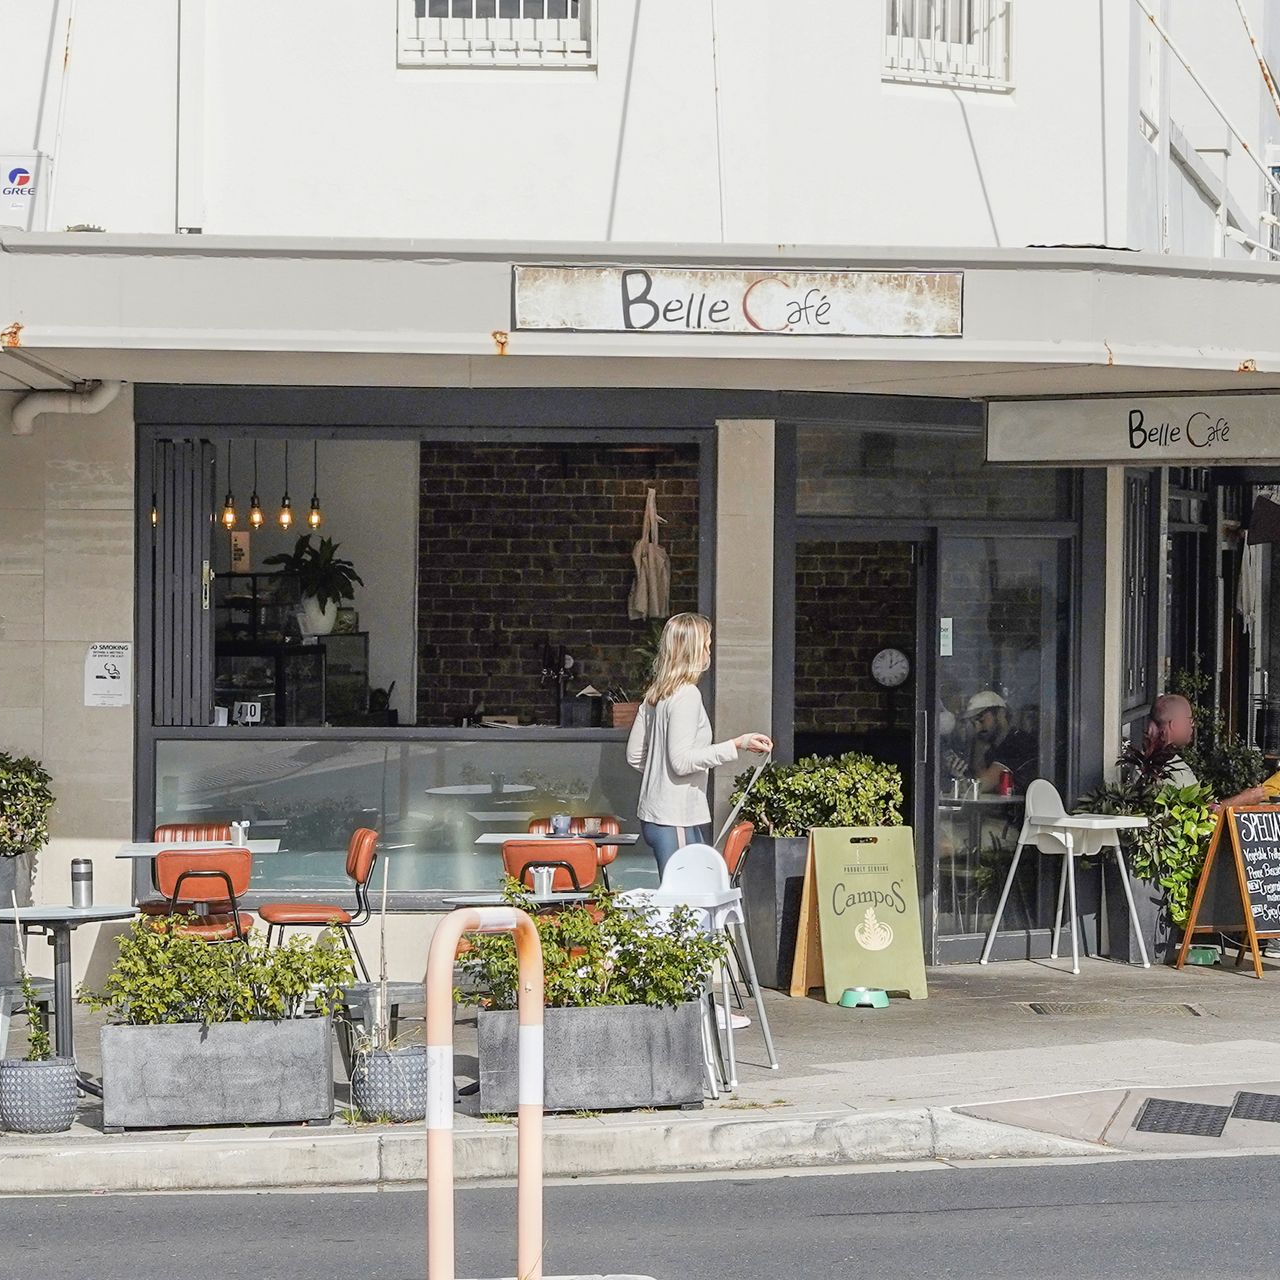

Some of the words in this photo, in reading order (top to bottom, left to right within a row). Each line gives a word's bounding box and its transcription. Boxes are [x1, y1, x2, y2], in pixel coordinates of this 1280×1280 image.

[2, 187, 36, 196] GREE
[621, 269, 730, 329] Belle
[742, 277, 831, 331] Café
[1129, 409, 1181, 448] Belle
[1186, 411, 1230, 447] Café
